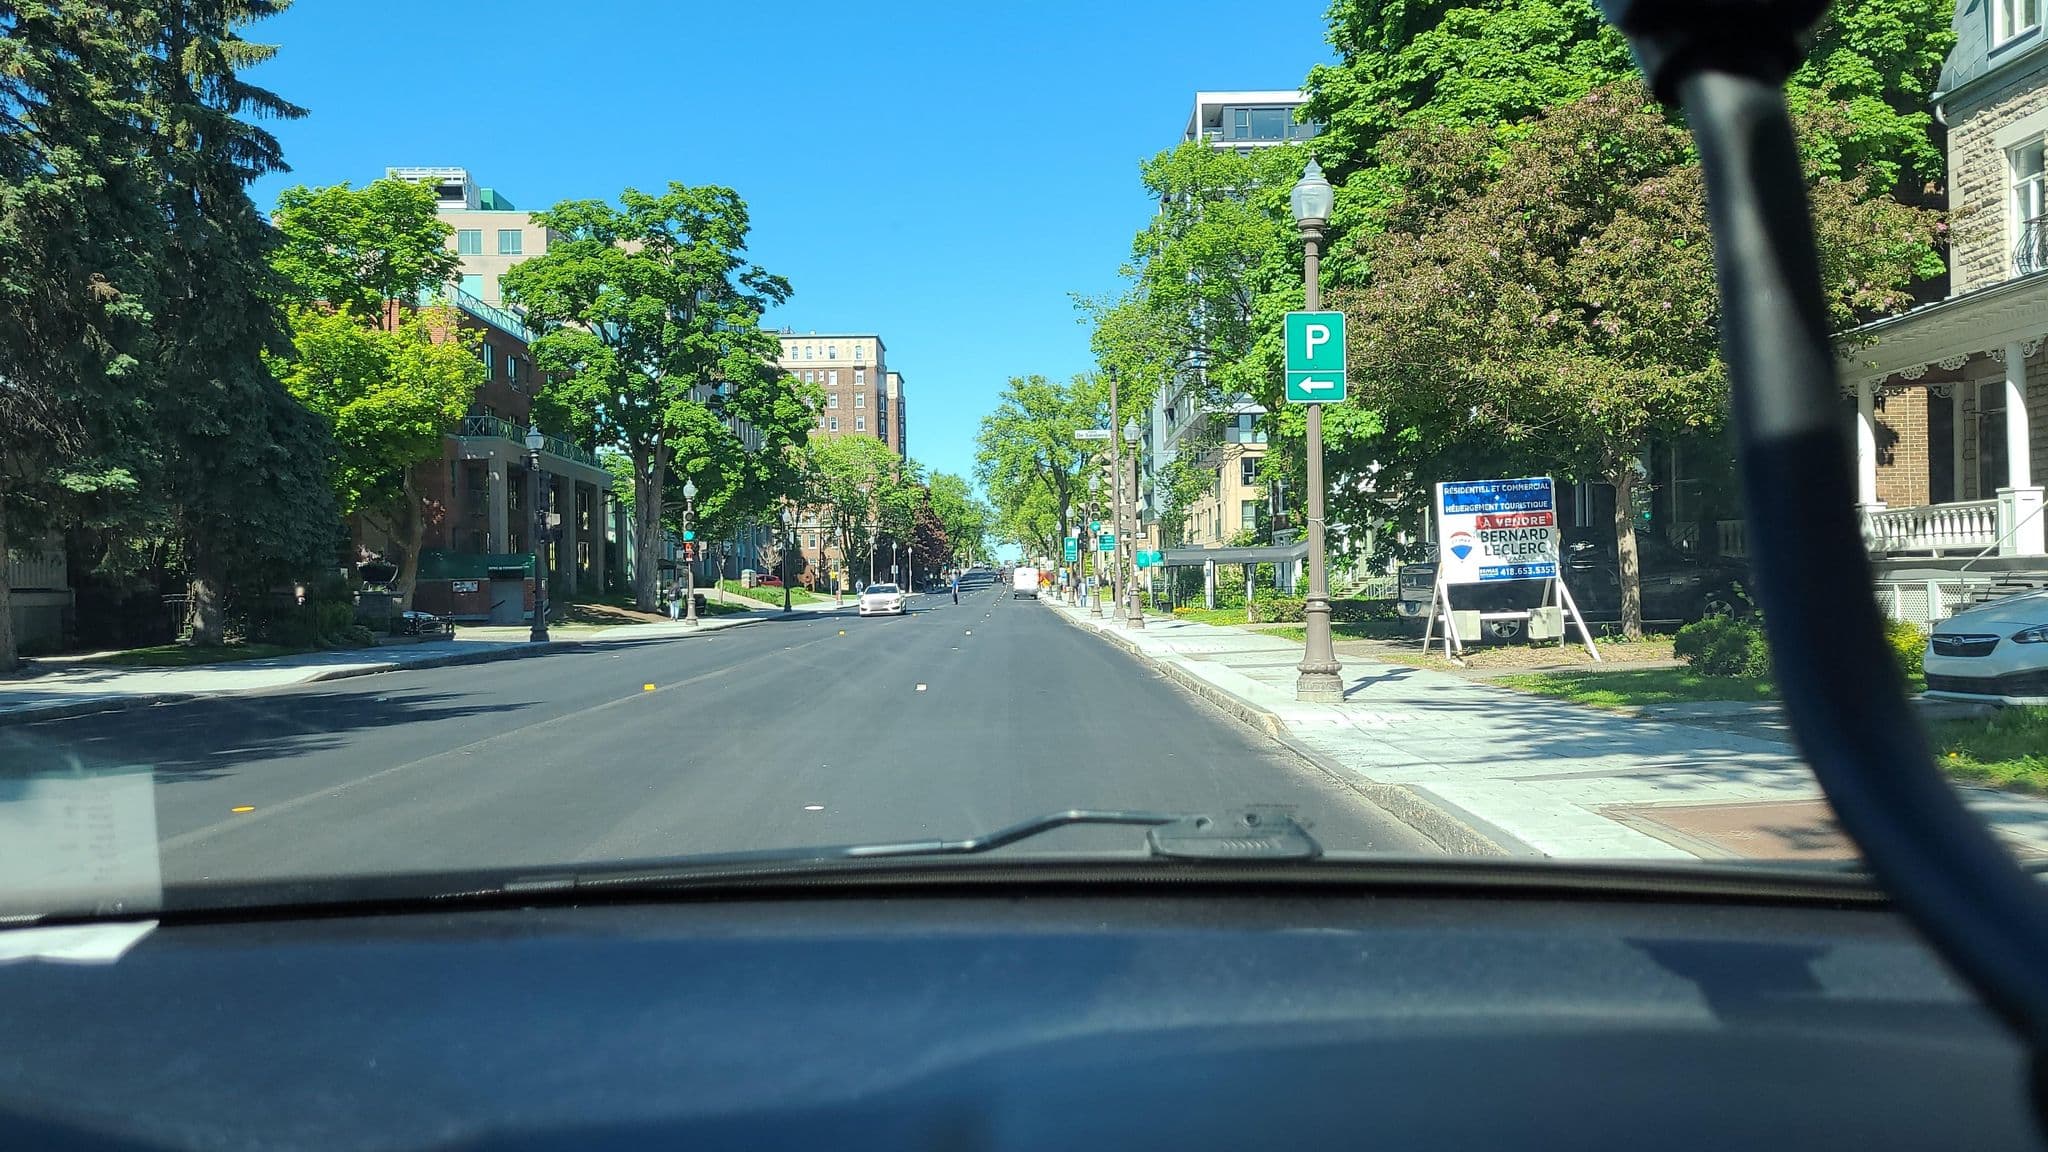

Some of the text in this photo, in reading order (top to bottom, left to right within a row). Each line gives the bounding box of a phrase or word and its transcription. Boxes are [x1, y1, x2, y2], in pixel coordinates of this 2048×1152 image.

[1306, 324, 1330, 360] P
[1444, 482, 1550, 495] RÉSIDENTIEL ET COMMERCIAL
[1445, 500, 1548, 513] HÉBERGEMENT TOURISTIQUE
[1496, 516, 1546, 527] VENDRE
[1480, 528, 1549, 543] BERNARD
[1484, 542, 1546, 556] LECLERC
[1500, 565, 1555, 576] 418.653.5353
